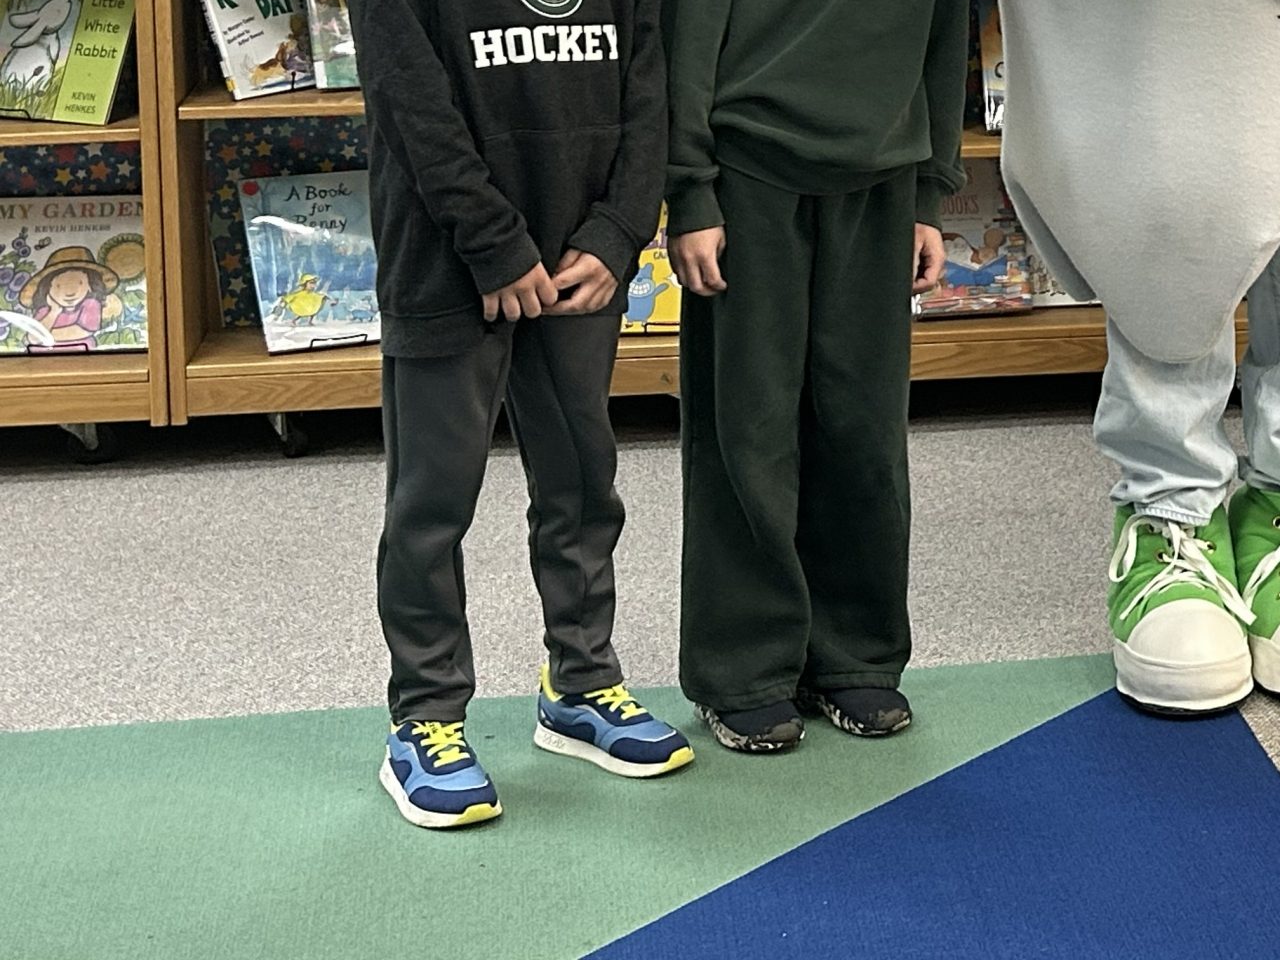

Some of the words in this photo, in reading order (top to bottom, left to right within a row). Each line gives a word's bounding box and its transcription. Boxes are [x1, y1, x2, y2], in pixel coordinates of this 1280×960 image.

[84, 19, 120, 34] White
[74, 43, 117, 59] Rabbit
[470, 24, 619, 69] HOCKEY
[72, 92, 96, 102] KEVIN
[64, 104, 96, 114] HENKES
[286, 185, 300, 201] A
[305, 183, 352, 200] Book
[0, 203, 34, 220] MY
[309, 203, 332, 216] for
[35, 225, 66, 233] KEVIN
